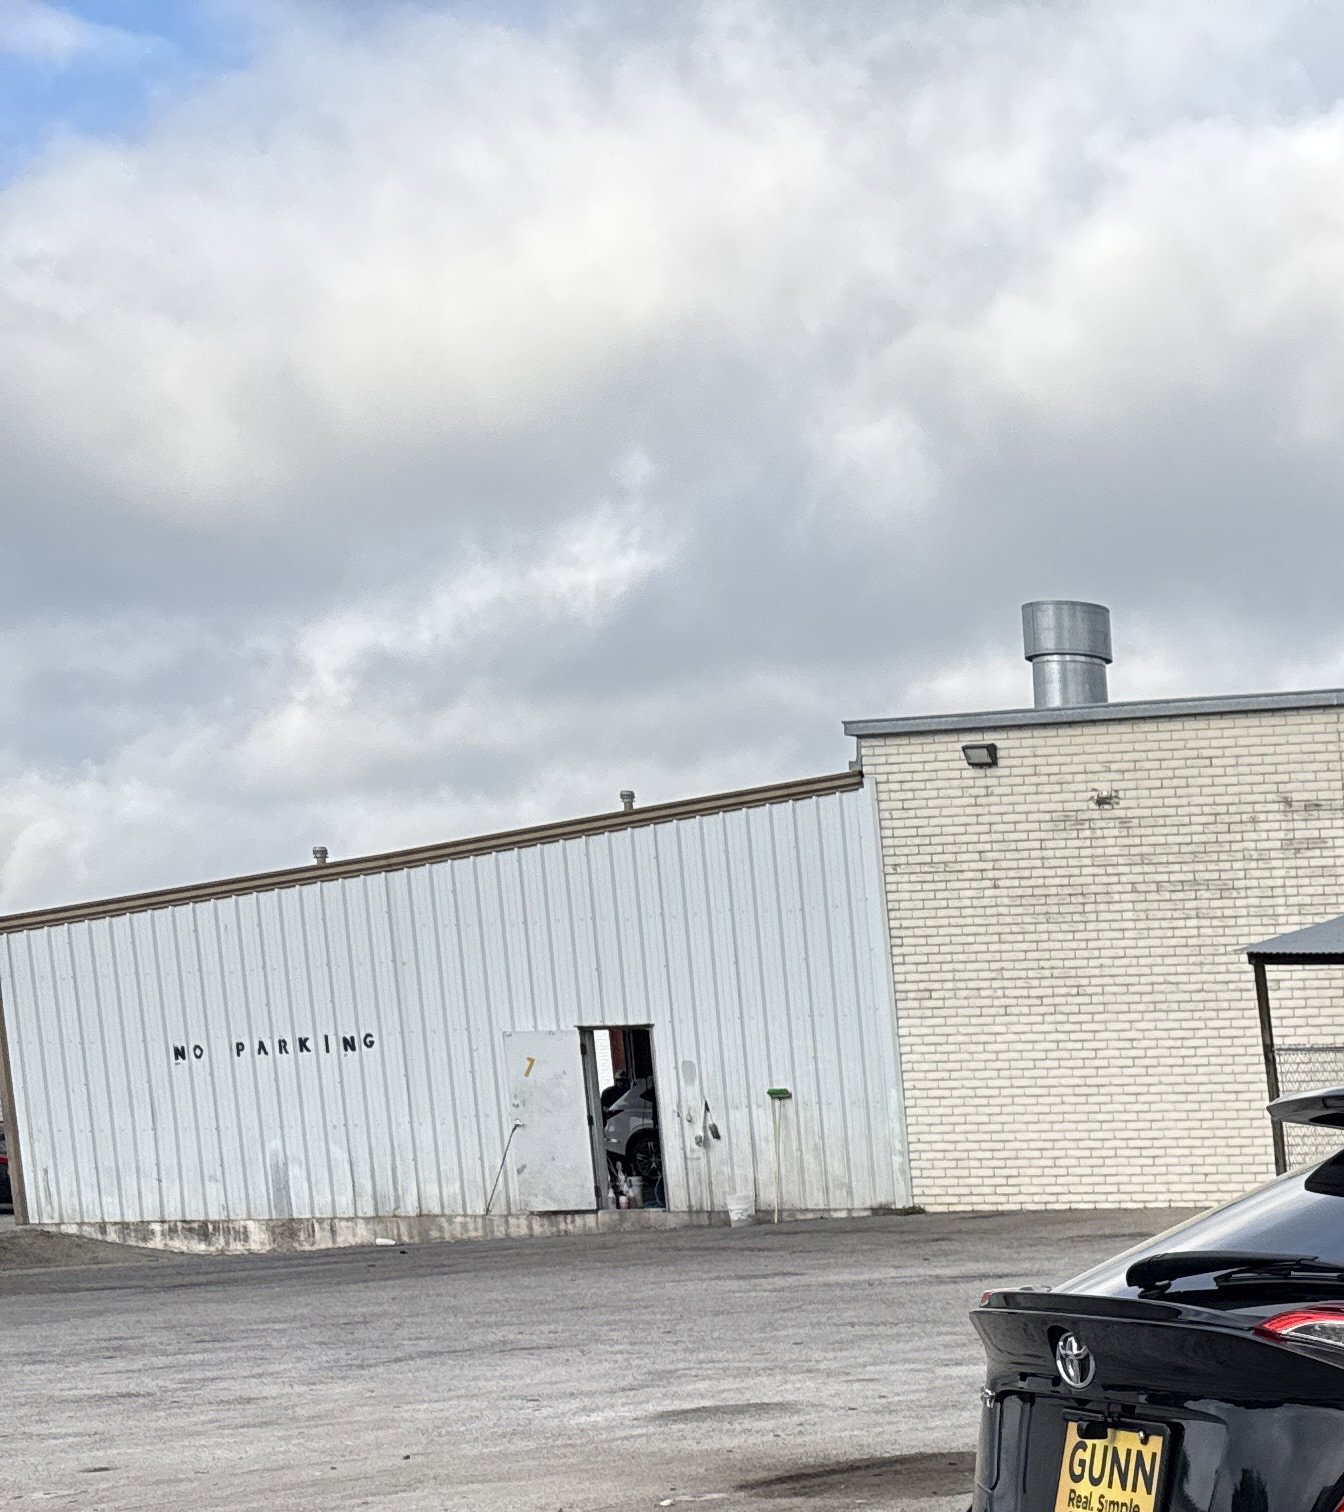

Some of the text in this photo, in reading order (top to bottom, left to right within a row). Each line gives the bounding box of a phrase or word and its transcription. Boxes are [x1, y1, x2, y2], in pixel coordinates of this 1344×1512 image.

[173, 1033, 375, 1061] NO PARKING
[1068, 1440, 1157, 1495] GUNN
[1067, 1488, 1093, 1512] Real.
